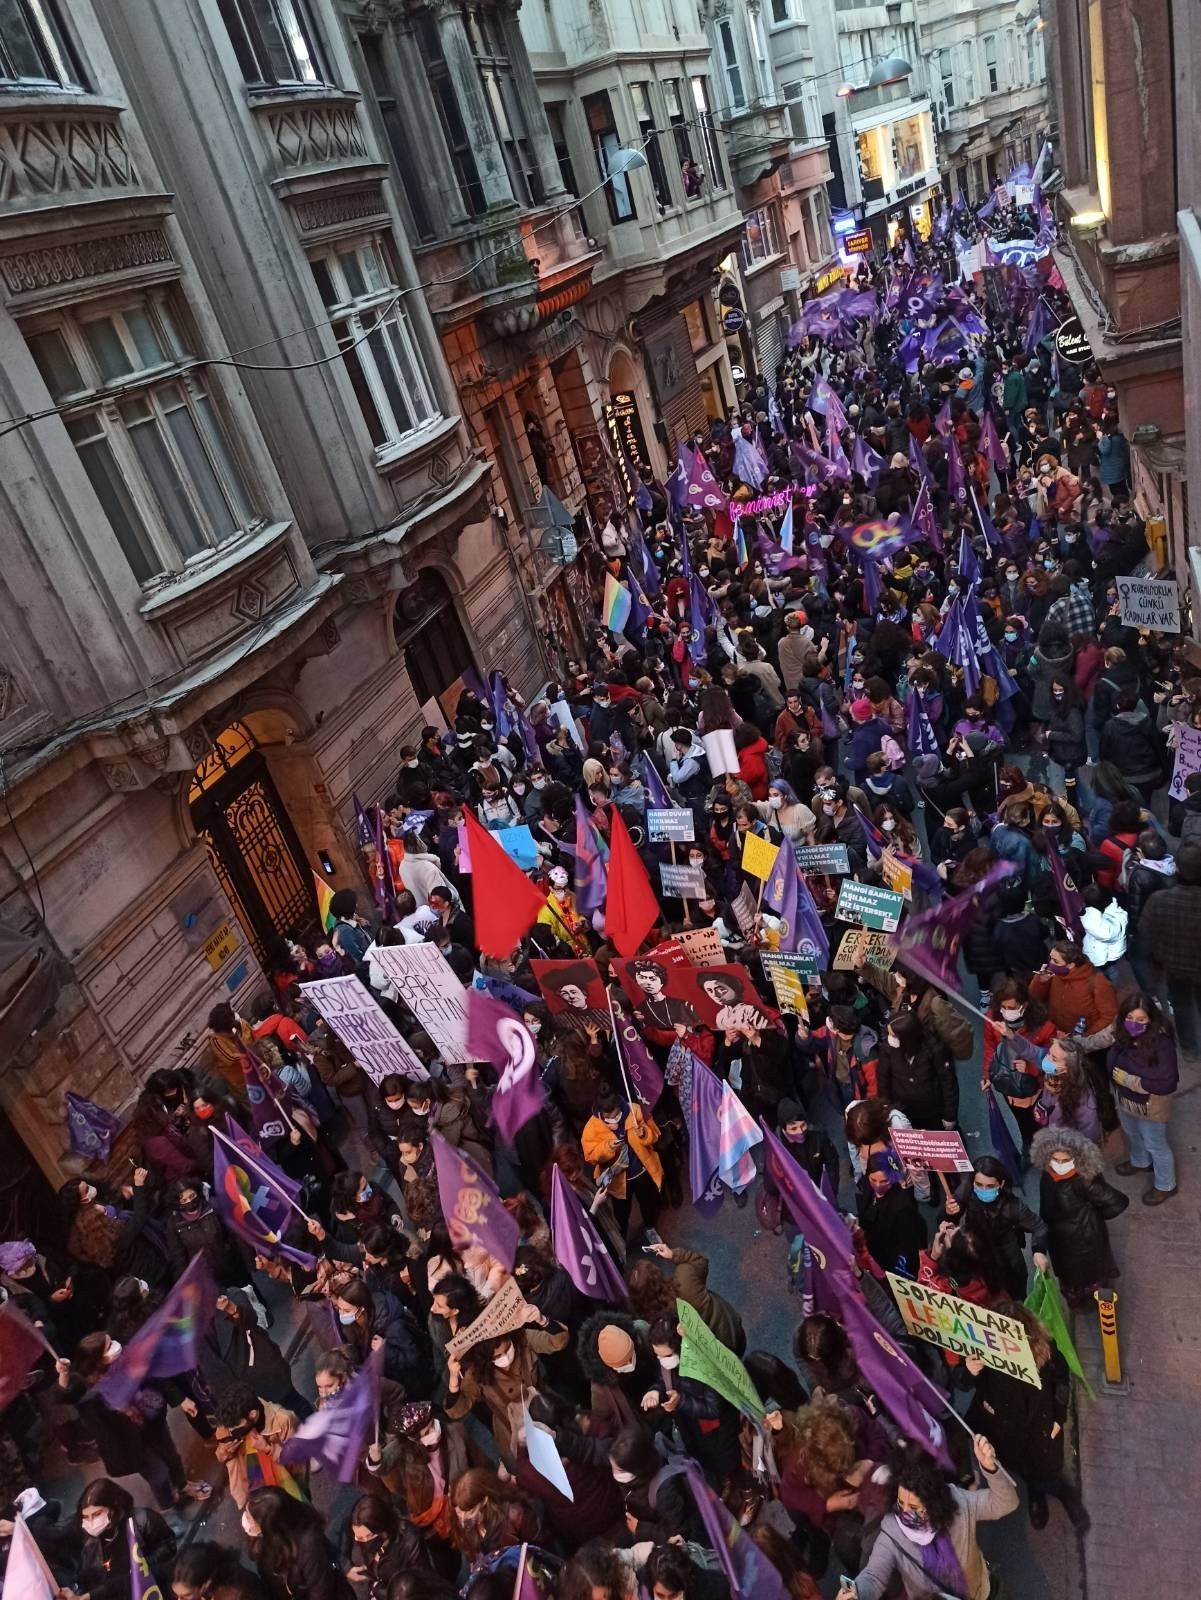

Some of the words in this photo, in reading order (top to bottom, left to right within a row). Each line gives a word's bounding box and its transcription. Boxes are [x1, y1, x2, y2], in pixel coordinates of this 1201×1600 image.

[729, 484, 793, 523] feminist
[1123, 609, 1158, 625] KADINLAR
[1158, 611, 1178, 626] VAR
[841, 891, 878, 906] AŞILMAZ
[843, 883, 868, 895] HANGİ
[867, 889, 903, 902] BARİKAT
[839, 901, 853, 909] BİZ
[905, 1298, 1022, 1356] LEBALEP
[912, 1322, 1036, 1383] DOLDURDUK
